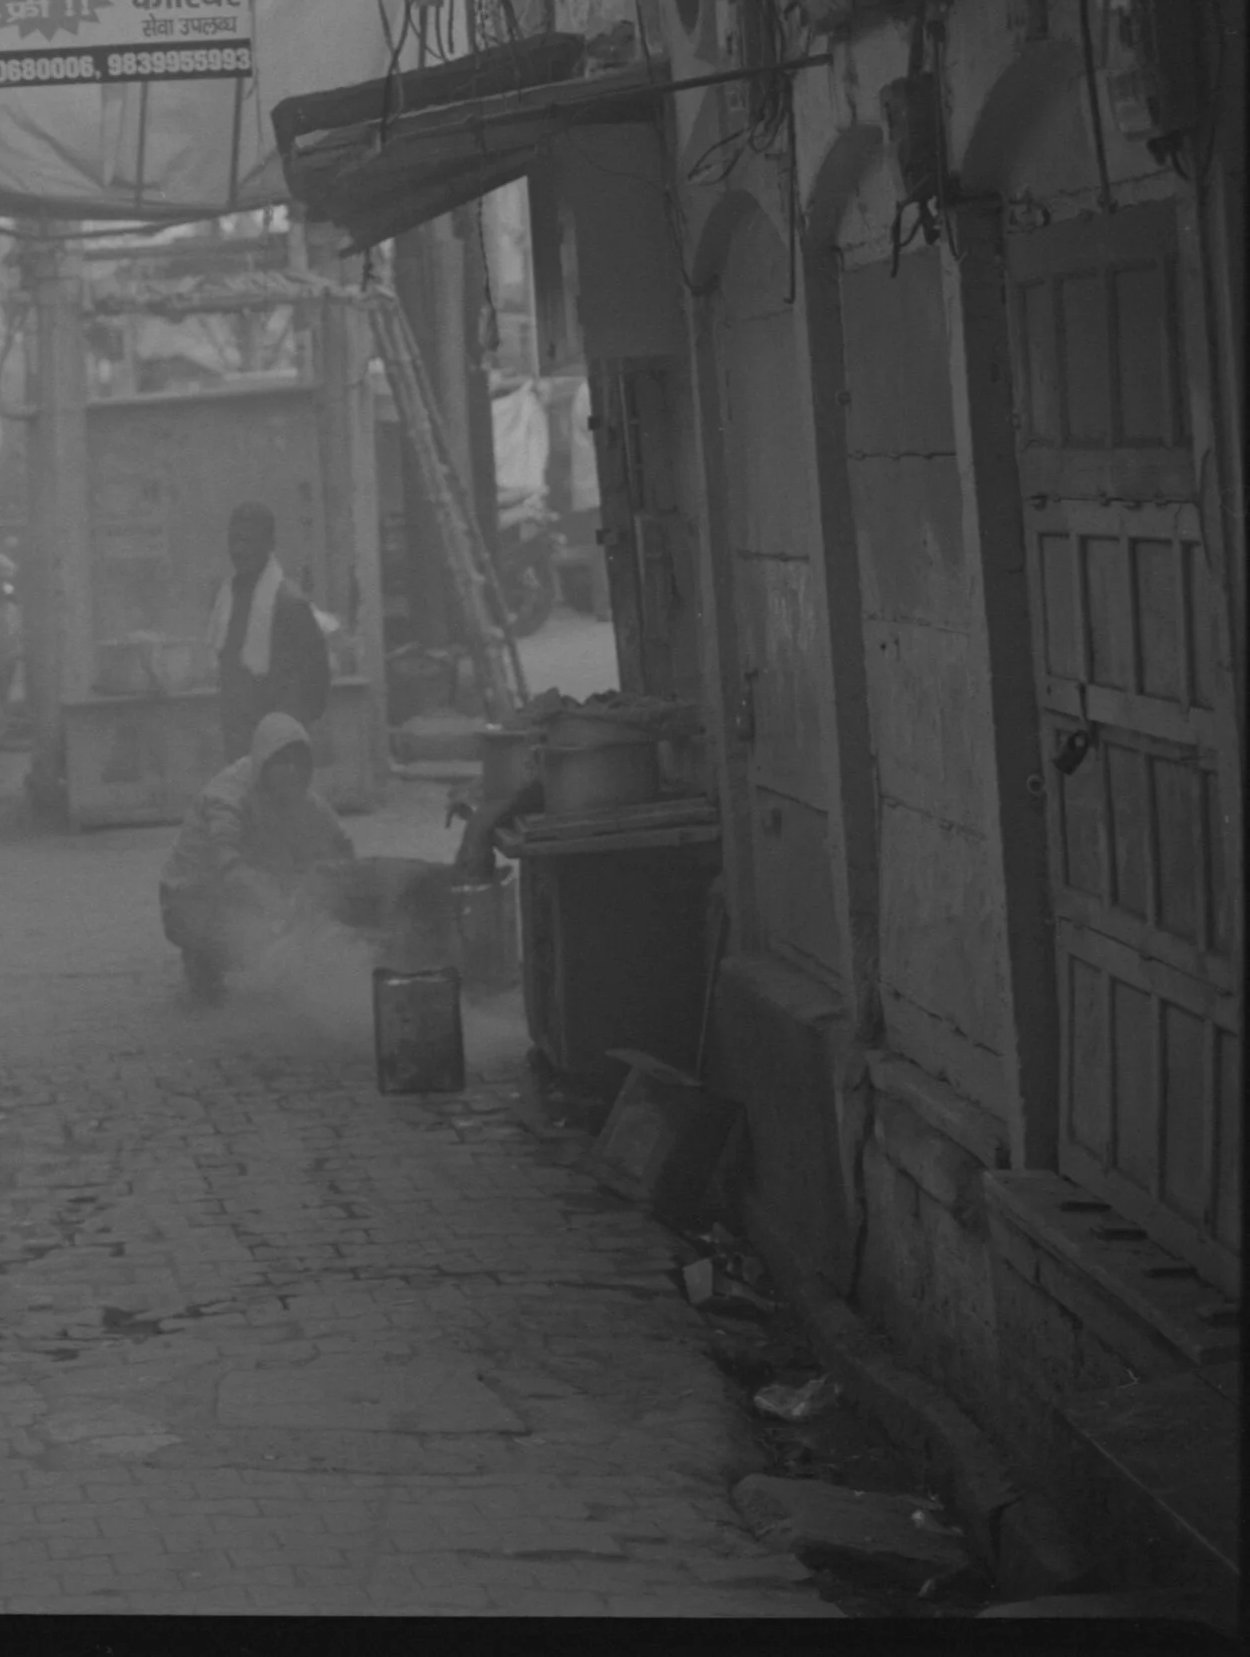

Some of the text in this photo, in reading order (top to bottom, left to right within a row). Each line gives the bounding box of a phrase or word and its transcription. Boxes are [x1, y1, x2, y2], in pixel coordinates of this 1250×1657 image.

[142, 13, 238, 37] सेवा उपलब्ध
[107, 46, 252, 77] 9839955993
